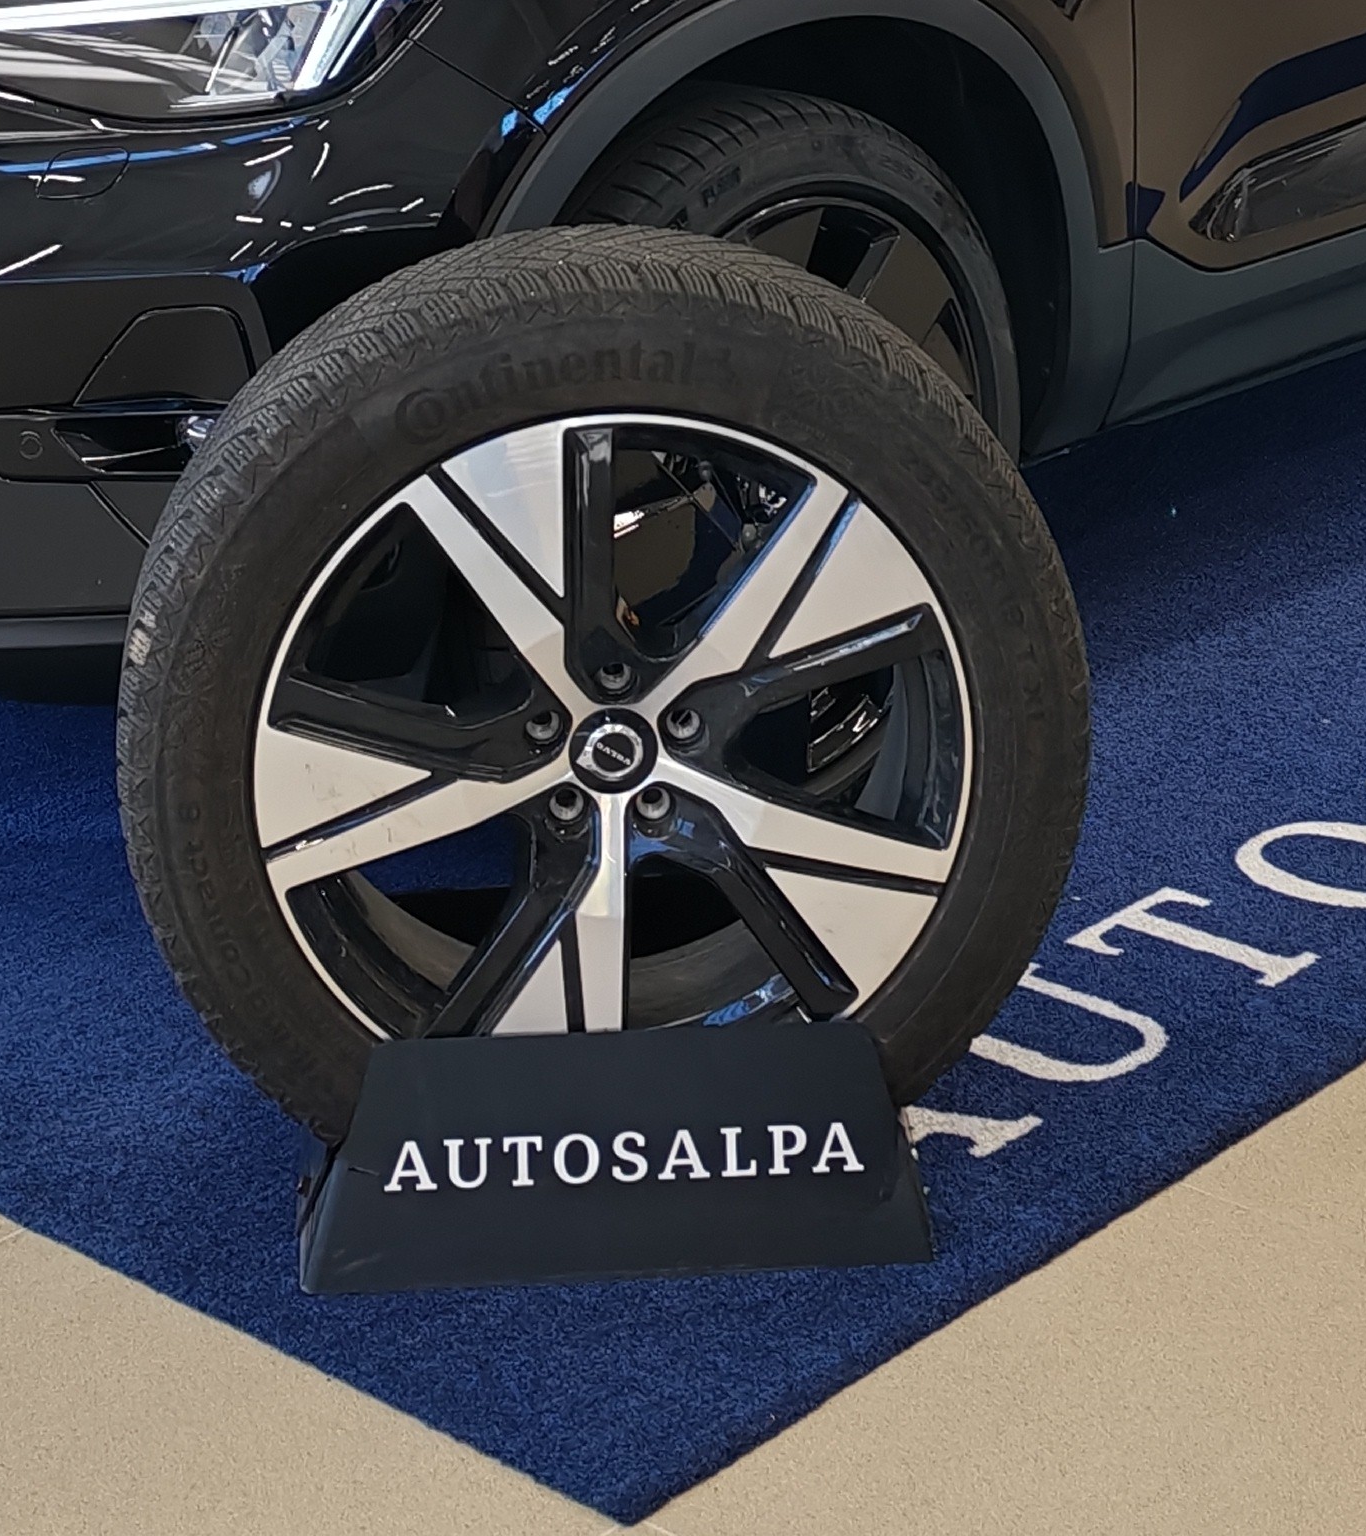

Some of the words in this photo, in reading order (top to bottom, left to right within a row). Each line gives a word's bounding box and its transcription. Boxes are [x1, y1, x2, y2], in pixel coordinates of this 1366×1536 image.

[395, 340, 697, 445] Continental
[596, 742, 631, 766] VOLVO
[383, 1121, 865, 1193] AUTOSALPA
